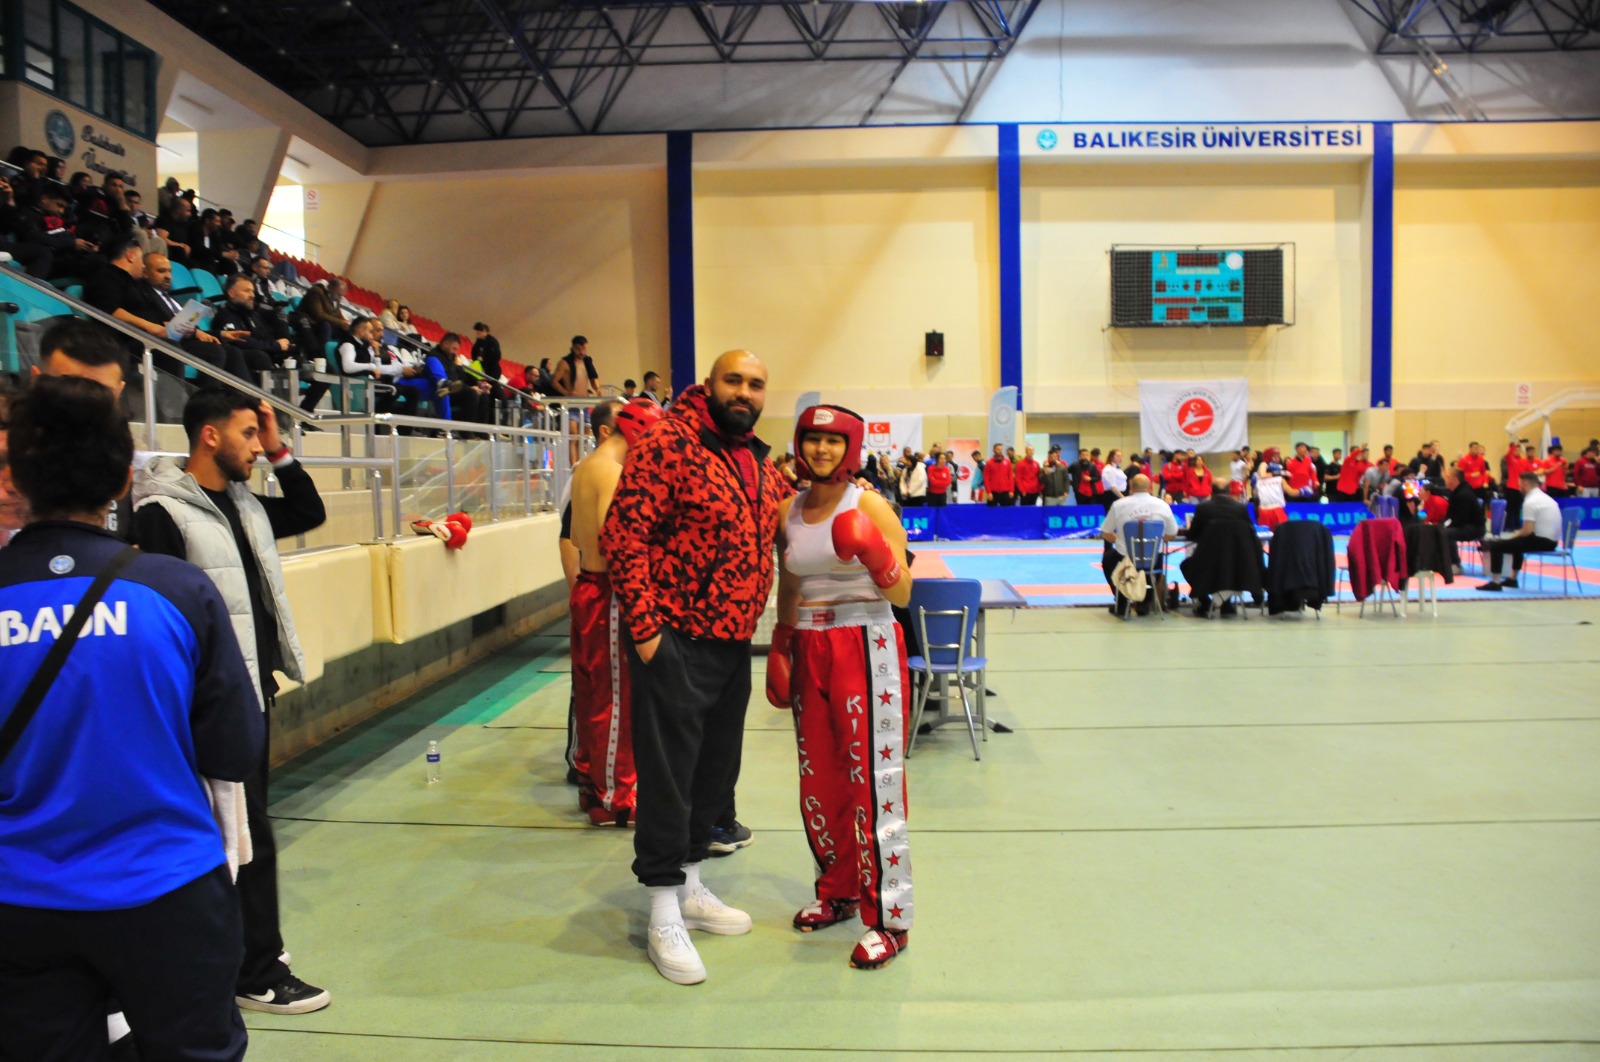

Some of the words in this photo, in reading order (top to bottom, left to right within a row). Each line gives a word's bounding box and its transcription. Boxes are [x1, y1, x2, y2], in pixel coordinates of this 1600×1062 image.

[1073, 127, 1197, 148] BALIKESİR
[1202, 125, 1362, 148] ÜNİVERSİTESİ
[846, 694, 865, 785] KICK
